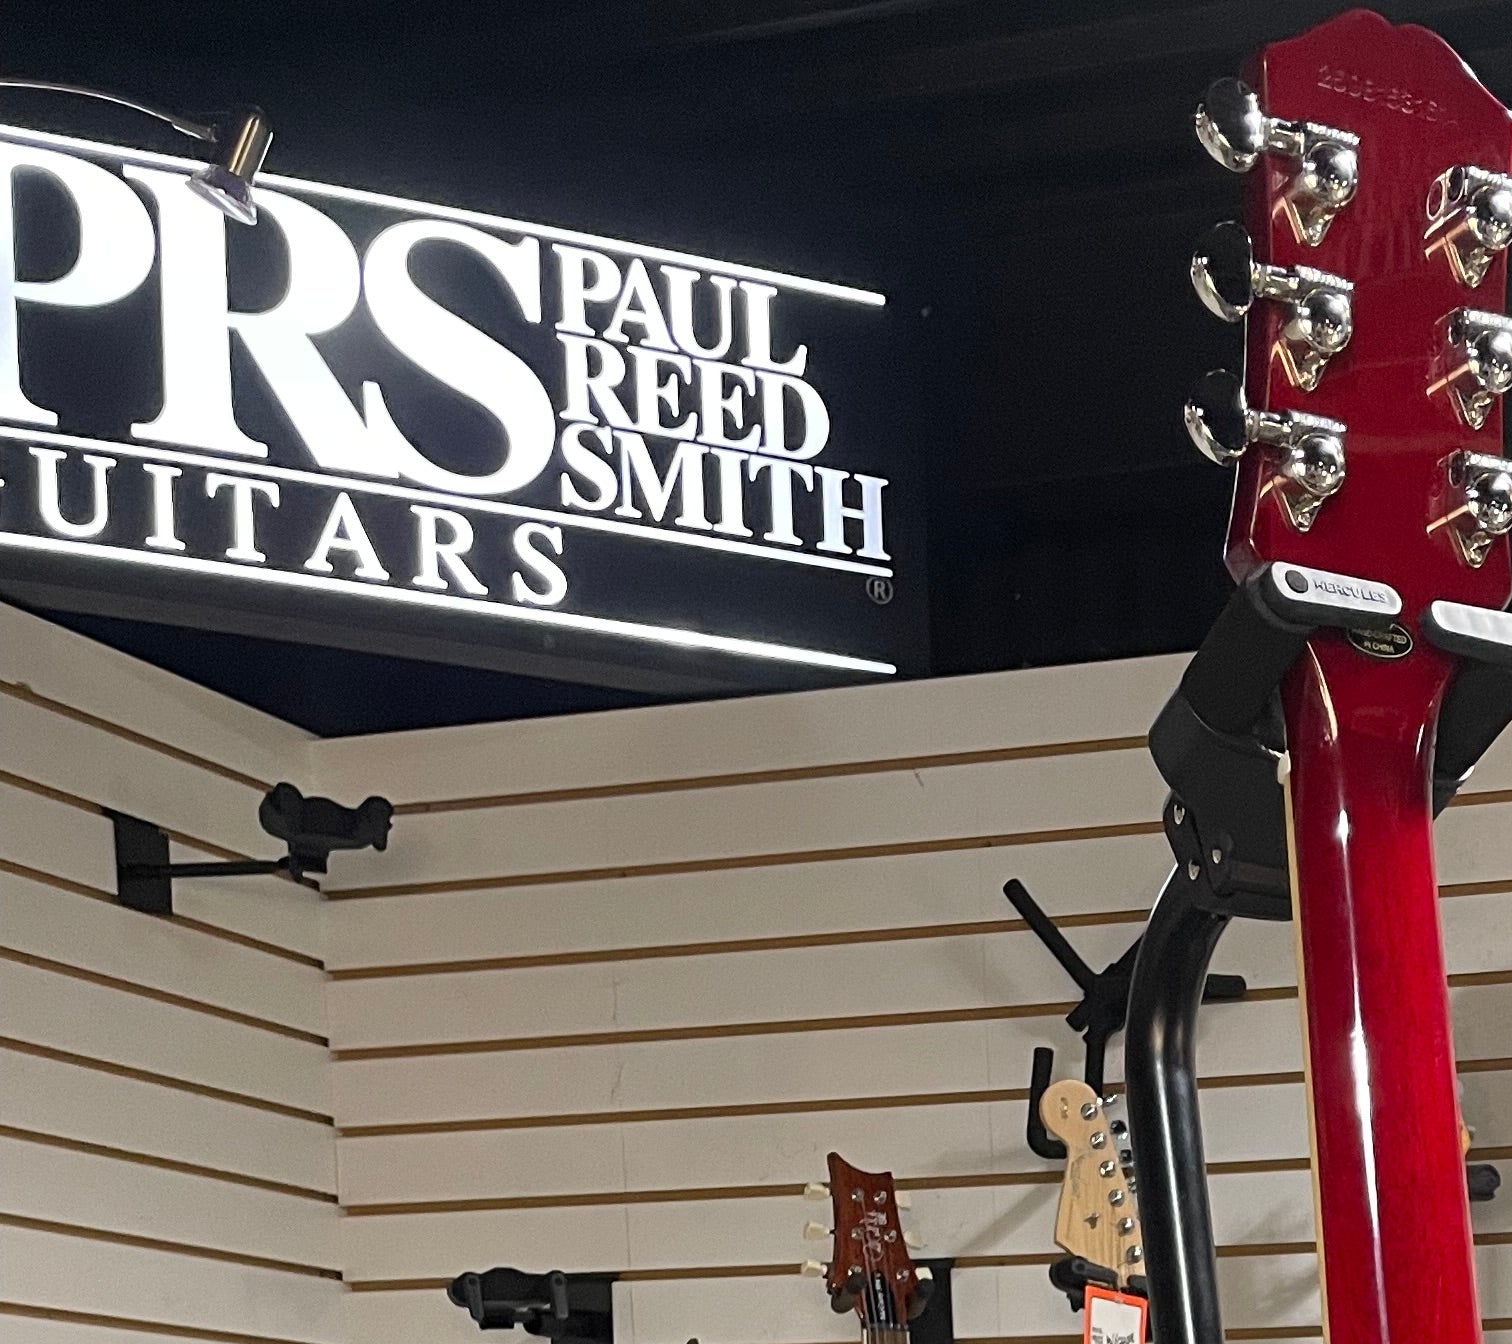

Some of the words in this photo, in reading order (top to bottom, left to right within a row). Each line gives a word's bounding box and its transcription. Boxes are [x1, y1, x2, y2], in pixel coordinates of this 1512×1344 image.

[0, 145, 557, 496] PRS
[551, 243, 808, 377] PAUL
[556, 331, 831, 461] REED
[0, 445, 568, 607] UITARS
[560, 422, 893, 562] SMITH
[1313, 580, 1387, 603] HERCULES
